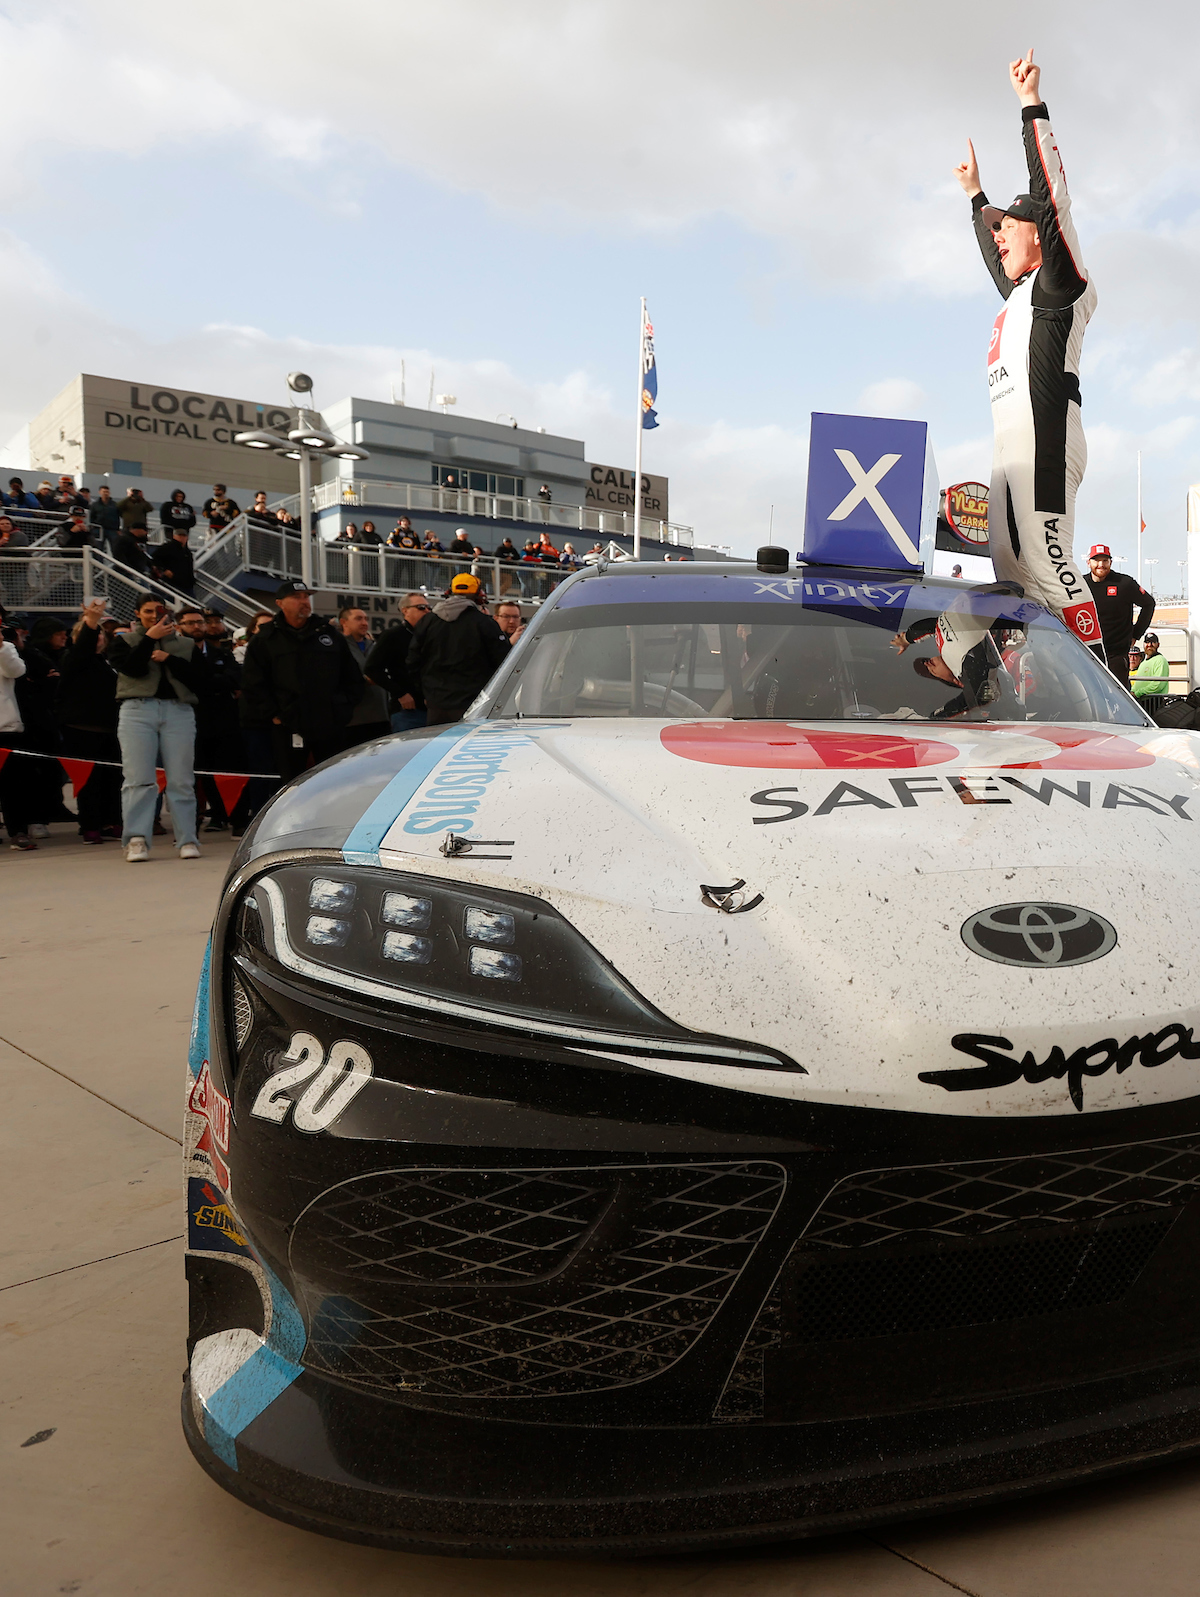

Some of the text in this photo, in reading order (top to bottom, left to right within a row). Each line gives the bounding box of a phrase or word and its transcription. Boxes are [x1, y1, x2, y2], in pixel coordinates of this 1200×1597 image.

[988, 366, 1009, 387] OTA
[104, 411, 207, 441] DIGITAL
[607, 491, 661, 511] CENER
[951, 491, 989, 516] Neo
[960, 515, 989, 530] GARAG
[1044, 518, 1083, 600] TOYOTA
[337, 594, 396, 612] MEN'
[753, 579, 905, 605] xfinity
[750, 776, 1194, 824] SAFEWAY
[251, 1030, 374, 1134] 20
[199, 1207, 239, 1234] SUN
